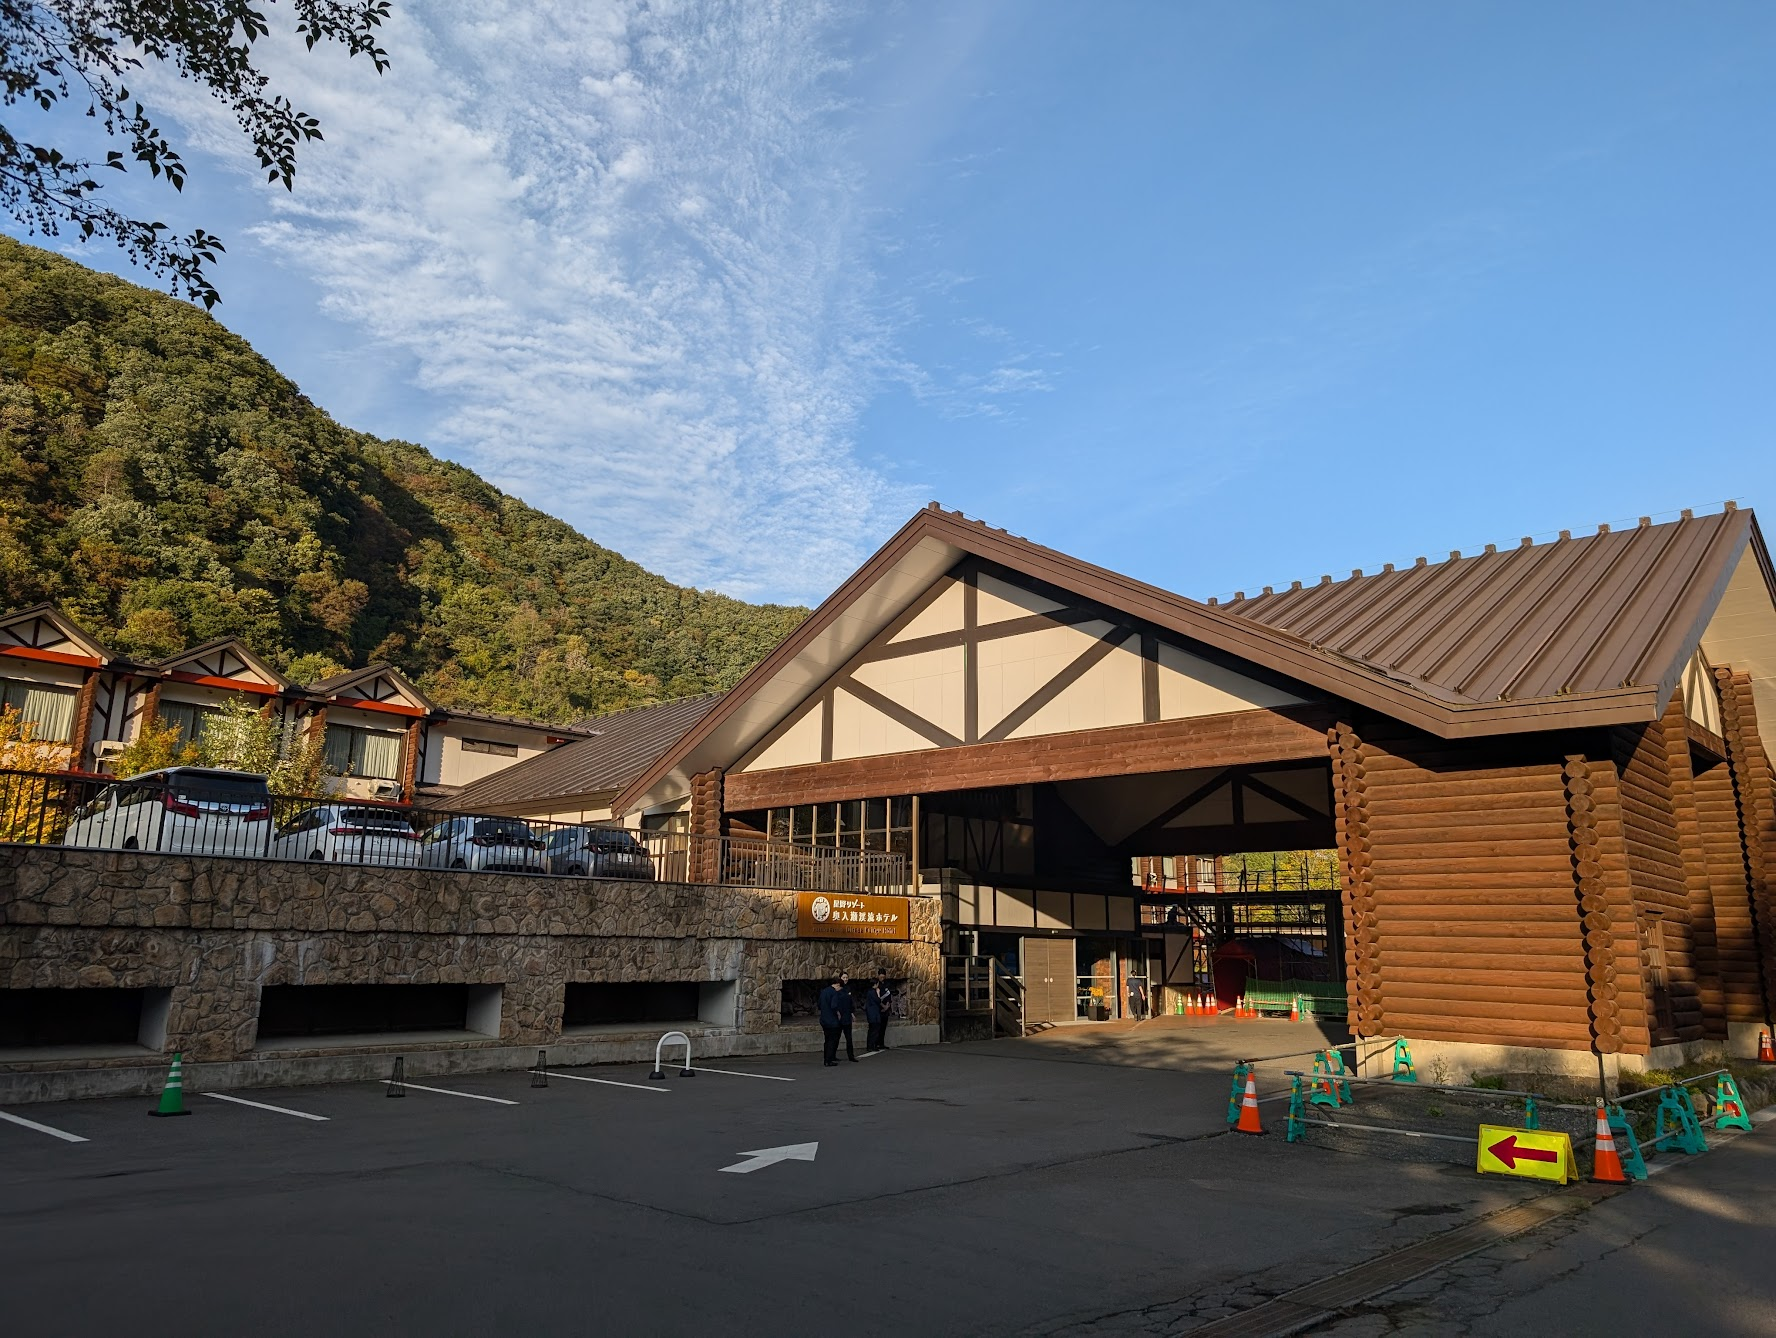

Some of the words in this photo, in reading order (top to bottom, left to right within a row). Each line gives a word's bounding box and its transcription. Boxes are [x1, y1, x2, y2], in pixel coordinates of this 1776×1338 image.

[832, 910, 898, 923] 奥入瀬渓流ホテル
